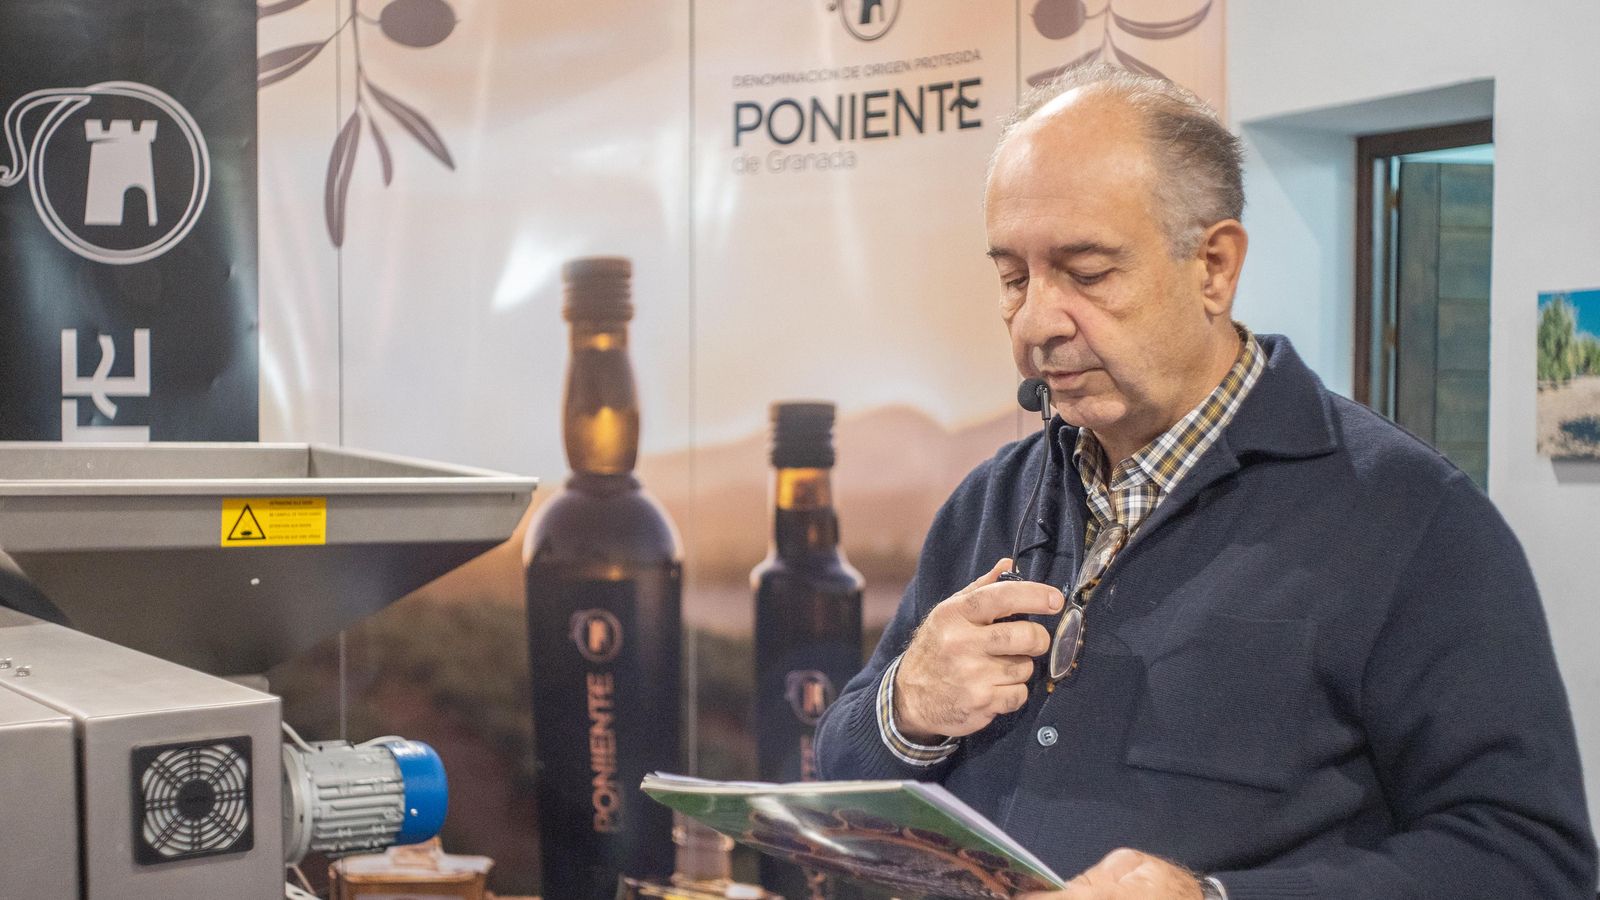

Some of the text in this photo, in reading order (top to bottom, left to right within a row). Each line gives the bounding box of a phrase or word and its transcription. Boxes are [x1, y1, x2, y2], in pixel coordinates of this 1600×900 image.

[842, 64, 860, 80] DE
[863, 60, 912, 77] ORIGEN
[915, 50, 982, 69] PROTEGIDA
[733, 78, 982, 147] PONIENTE
[732, 149, 857, 175] de Granada
[586, 672, 621, 832] PONIENTE
